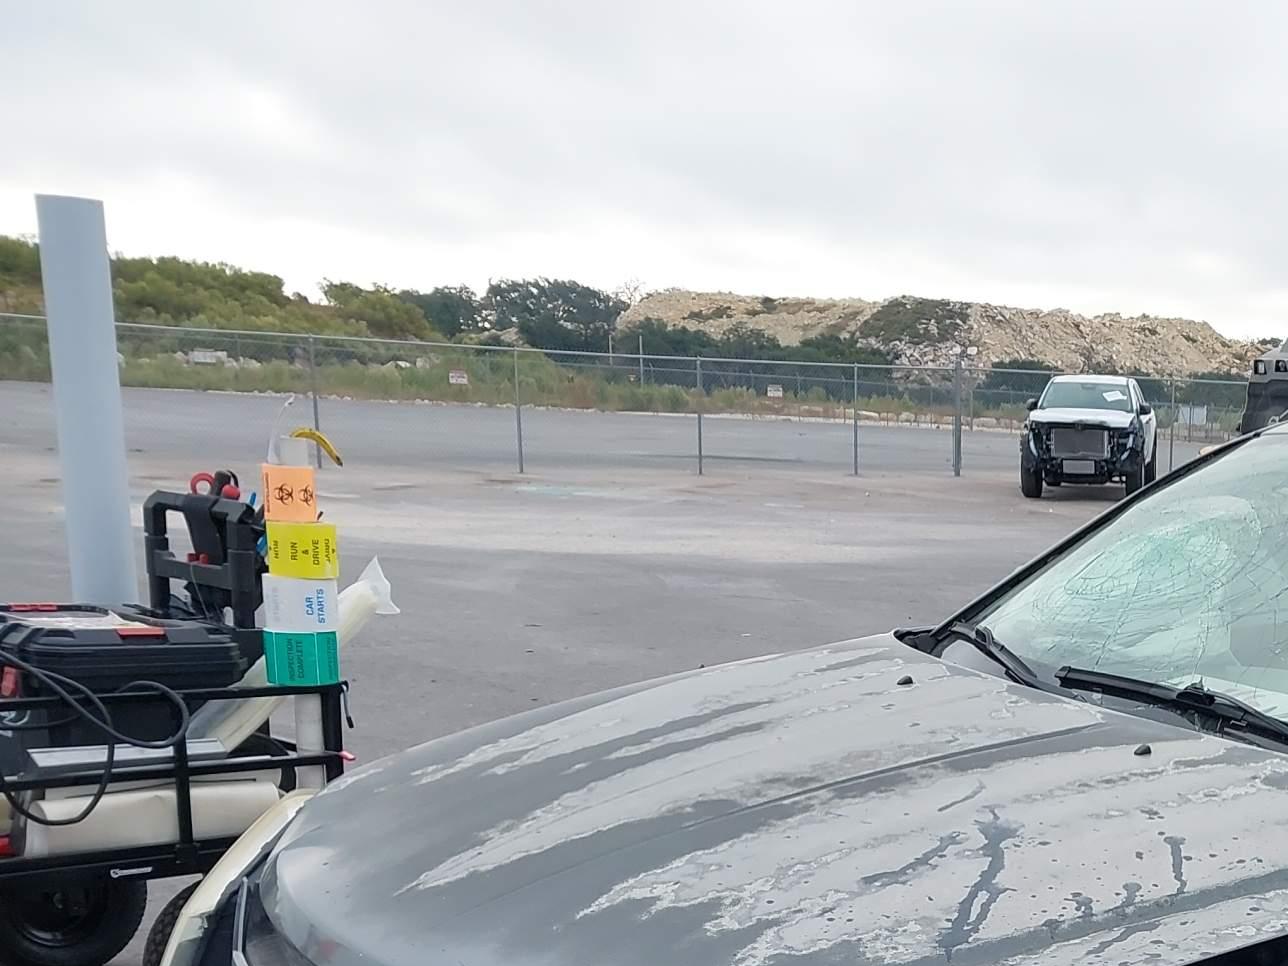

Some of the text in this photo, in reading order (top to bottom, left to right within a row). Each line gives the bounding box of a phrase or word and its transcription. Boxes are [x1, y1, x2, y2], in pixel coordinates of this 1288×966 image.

[290, 541, 298, 561] RUN
[312, 539, 320, 566] DRIVE
[305, 596, 314, 616] CAR
[316, 588, 326, 624] STARTS
